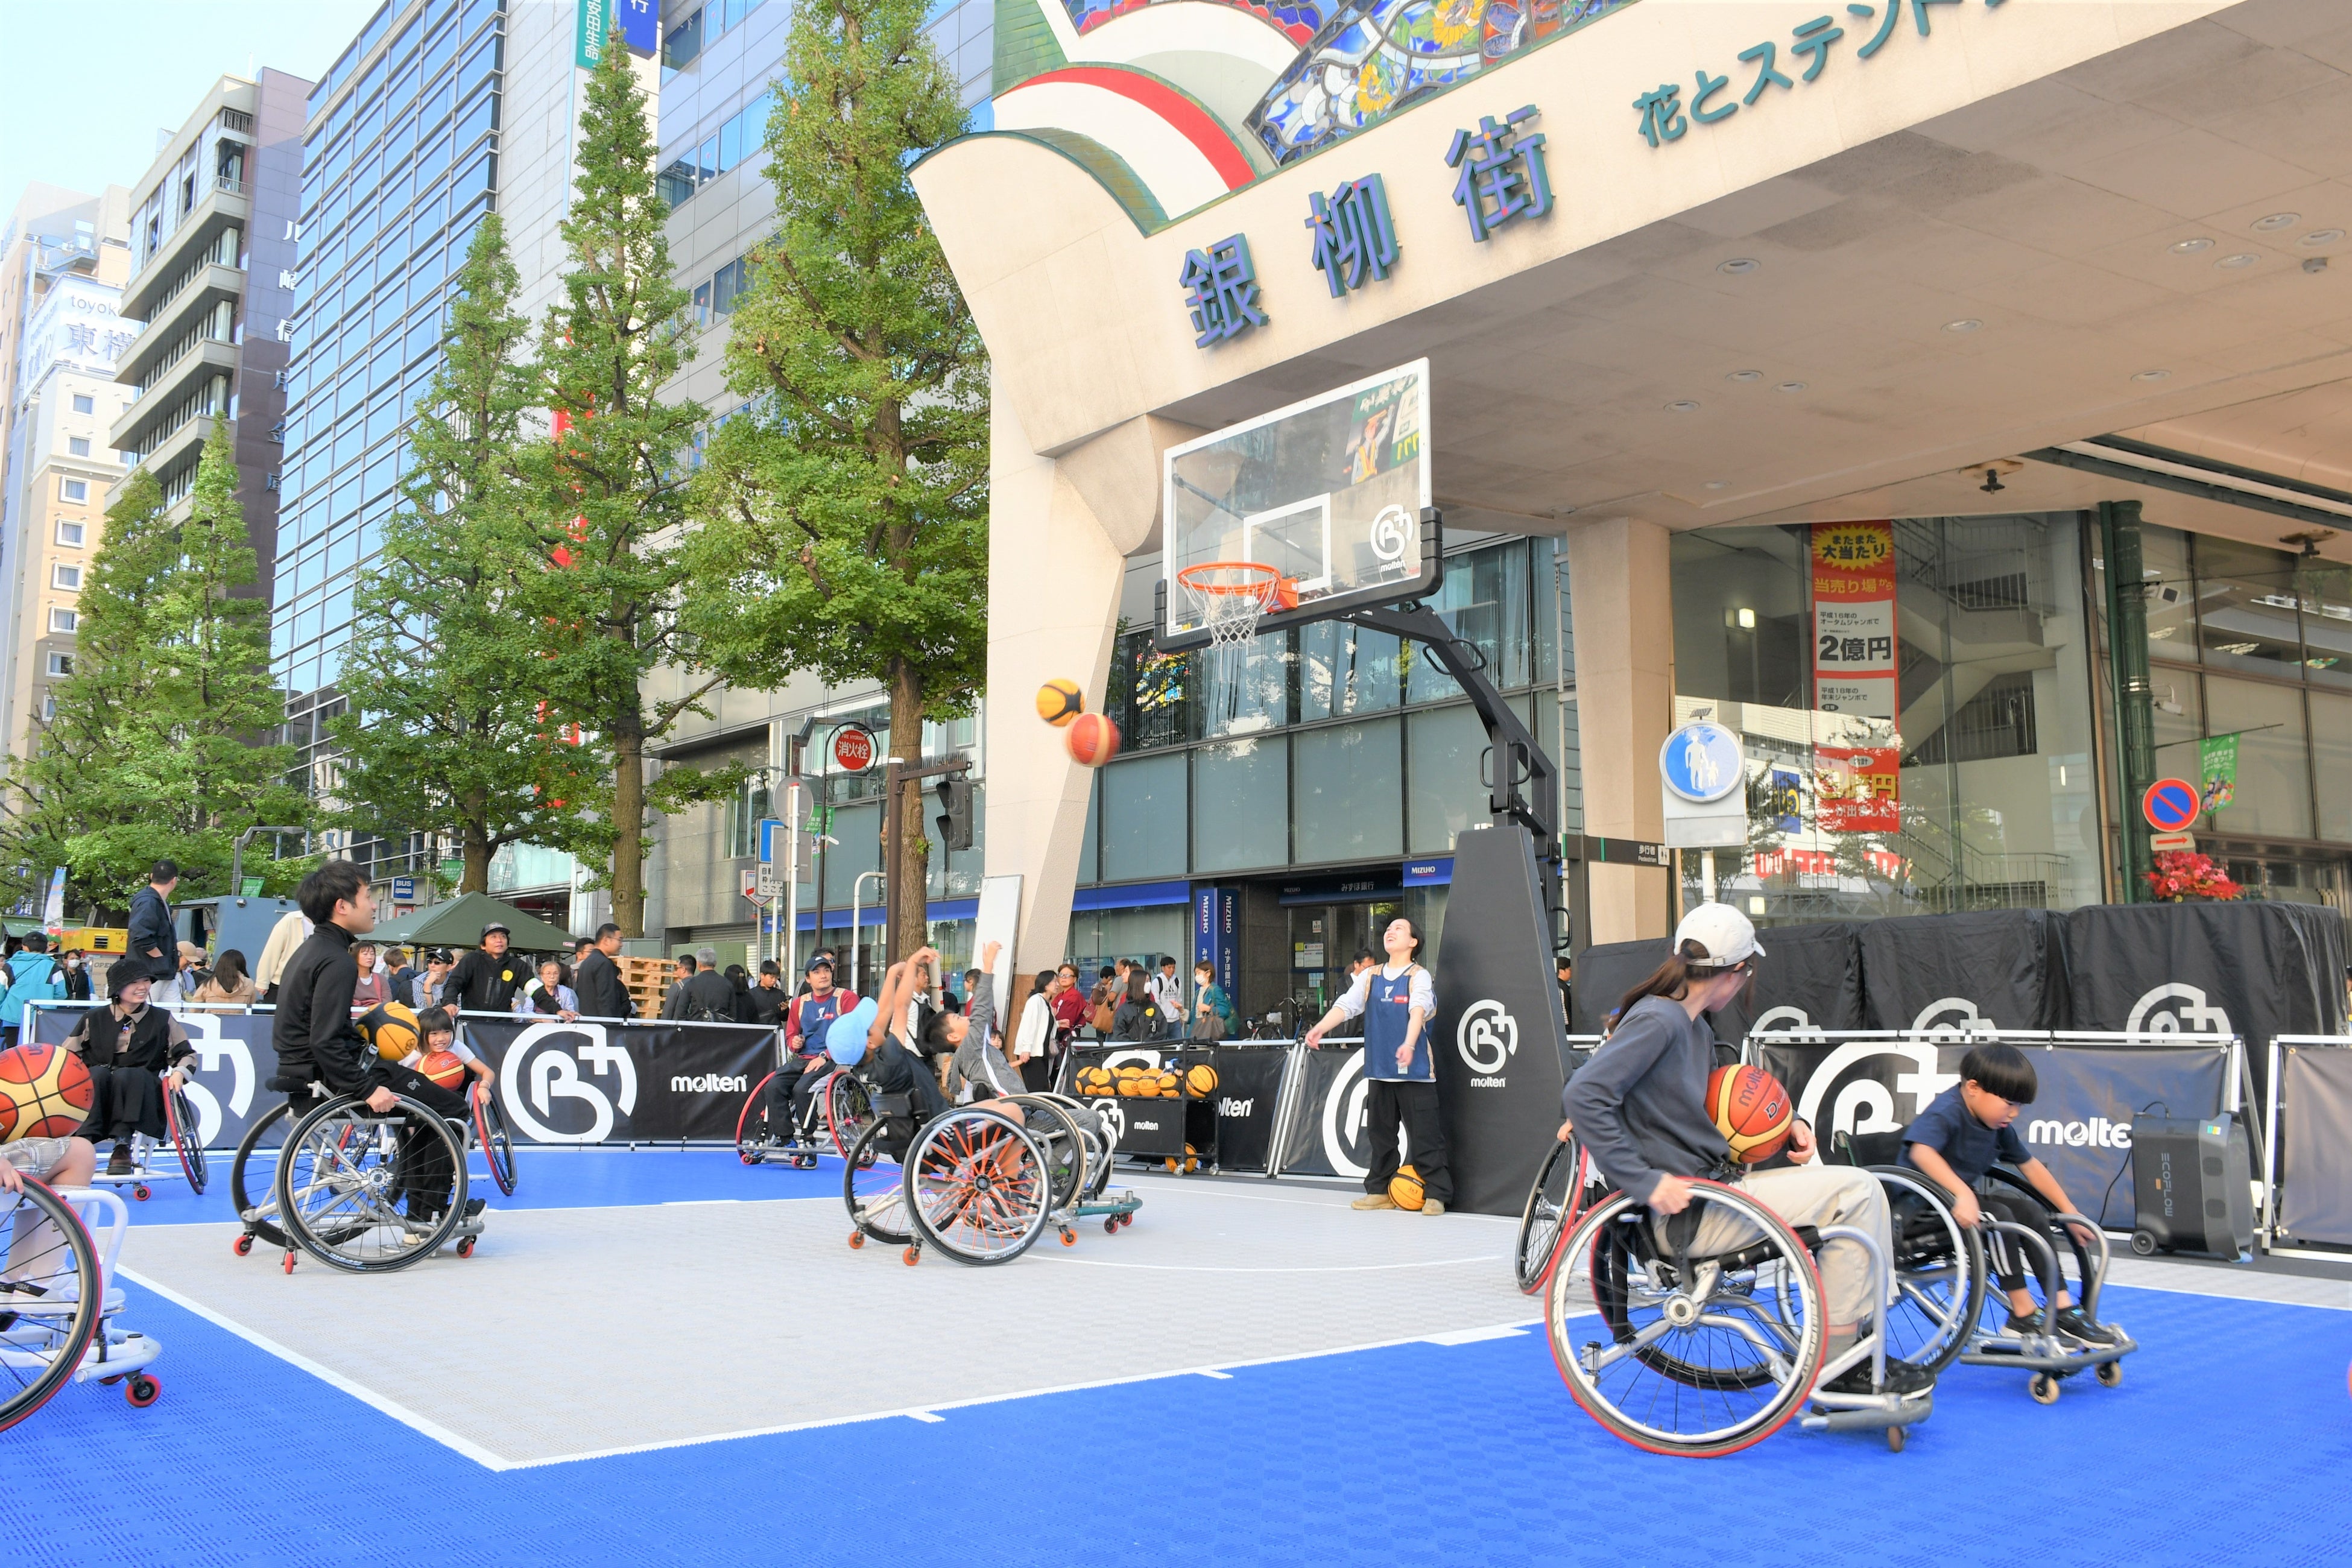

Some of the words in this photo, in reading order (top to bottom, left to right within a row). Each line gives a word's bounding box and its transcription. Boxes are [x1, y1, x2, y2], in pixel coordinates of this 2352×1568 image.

[584, 0, 602, 60] 安田生命
[1178, 104, 1554, 349] 銀柳街
[1833, 534, 1877, 545] またまた
[1822, 543, 1886, 560] 大当たり
[1380, 560, 1406, 573] molten
[1815, 577, 1894, 594] 当売り場から
[1819, 635, 1892, 662] 2億円
[838, 741, 869, 759] 消火栓
[1639, 845, 1656, 855] 歩行者
[1411, 866, 1436, 874] MIZUHO
[1341, 881, 1374, 892] みずほ銀行
[671, 1073, 748, 1093] molten
[1470, 1076, 1506, 1088] molten
[1134, 1120, 1159, 1131] molten
[2161, 1152, 2173, 1217] ECOFLOW
